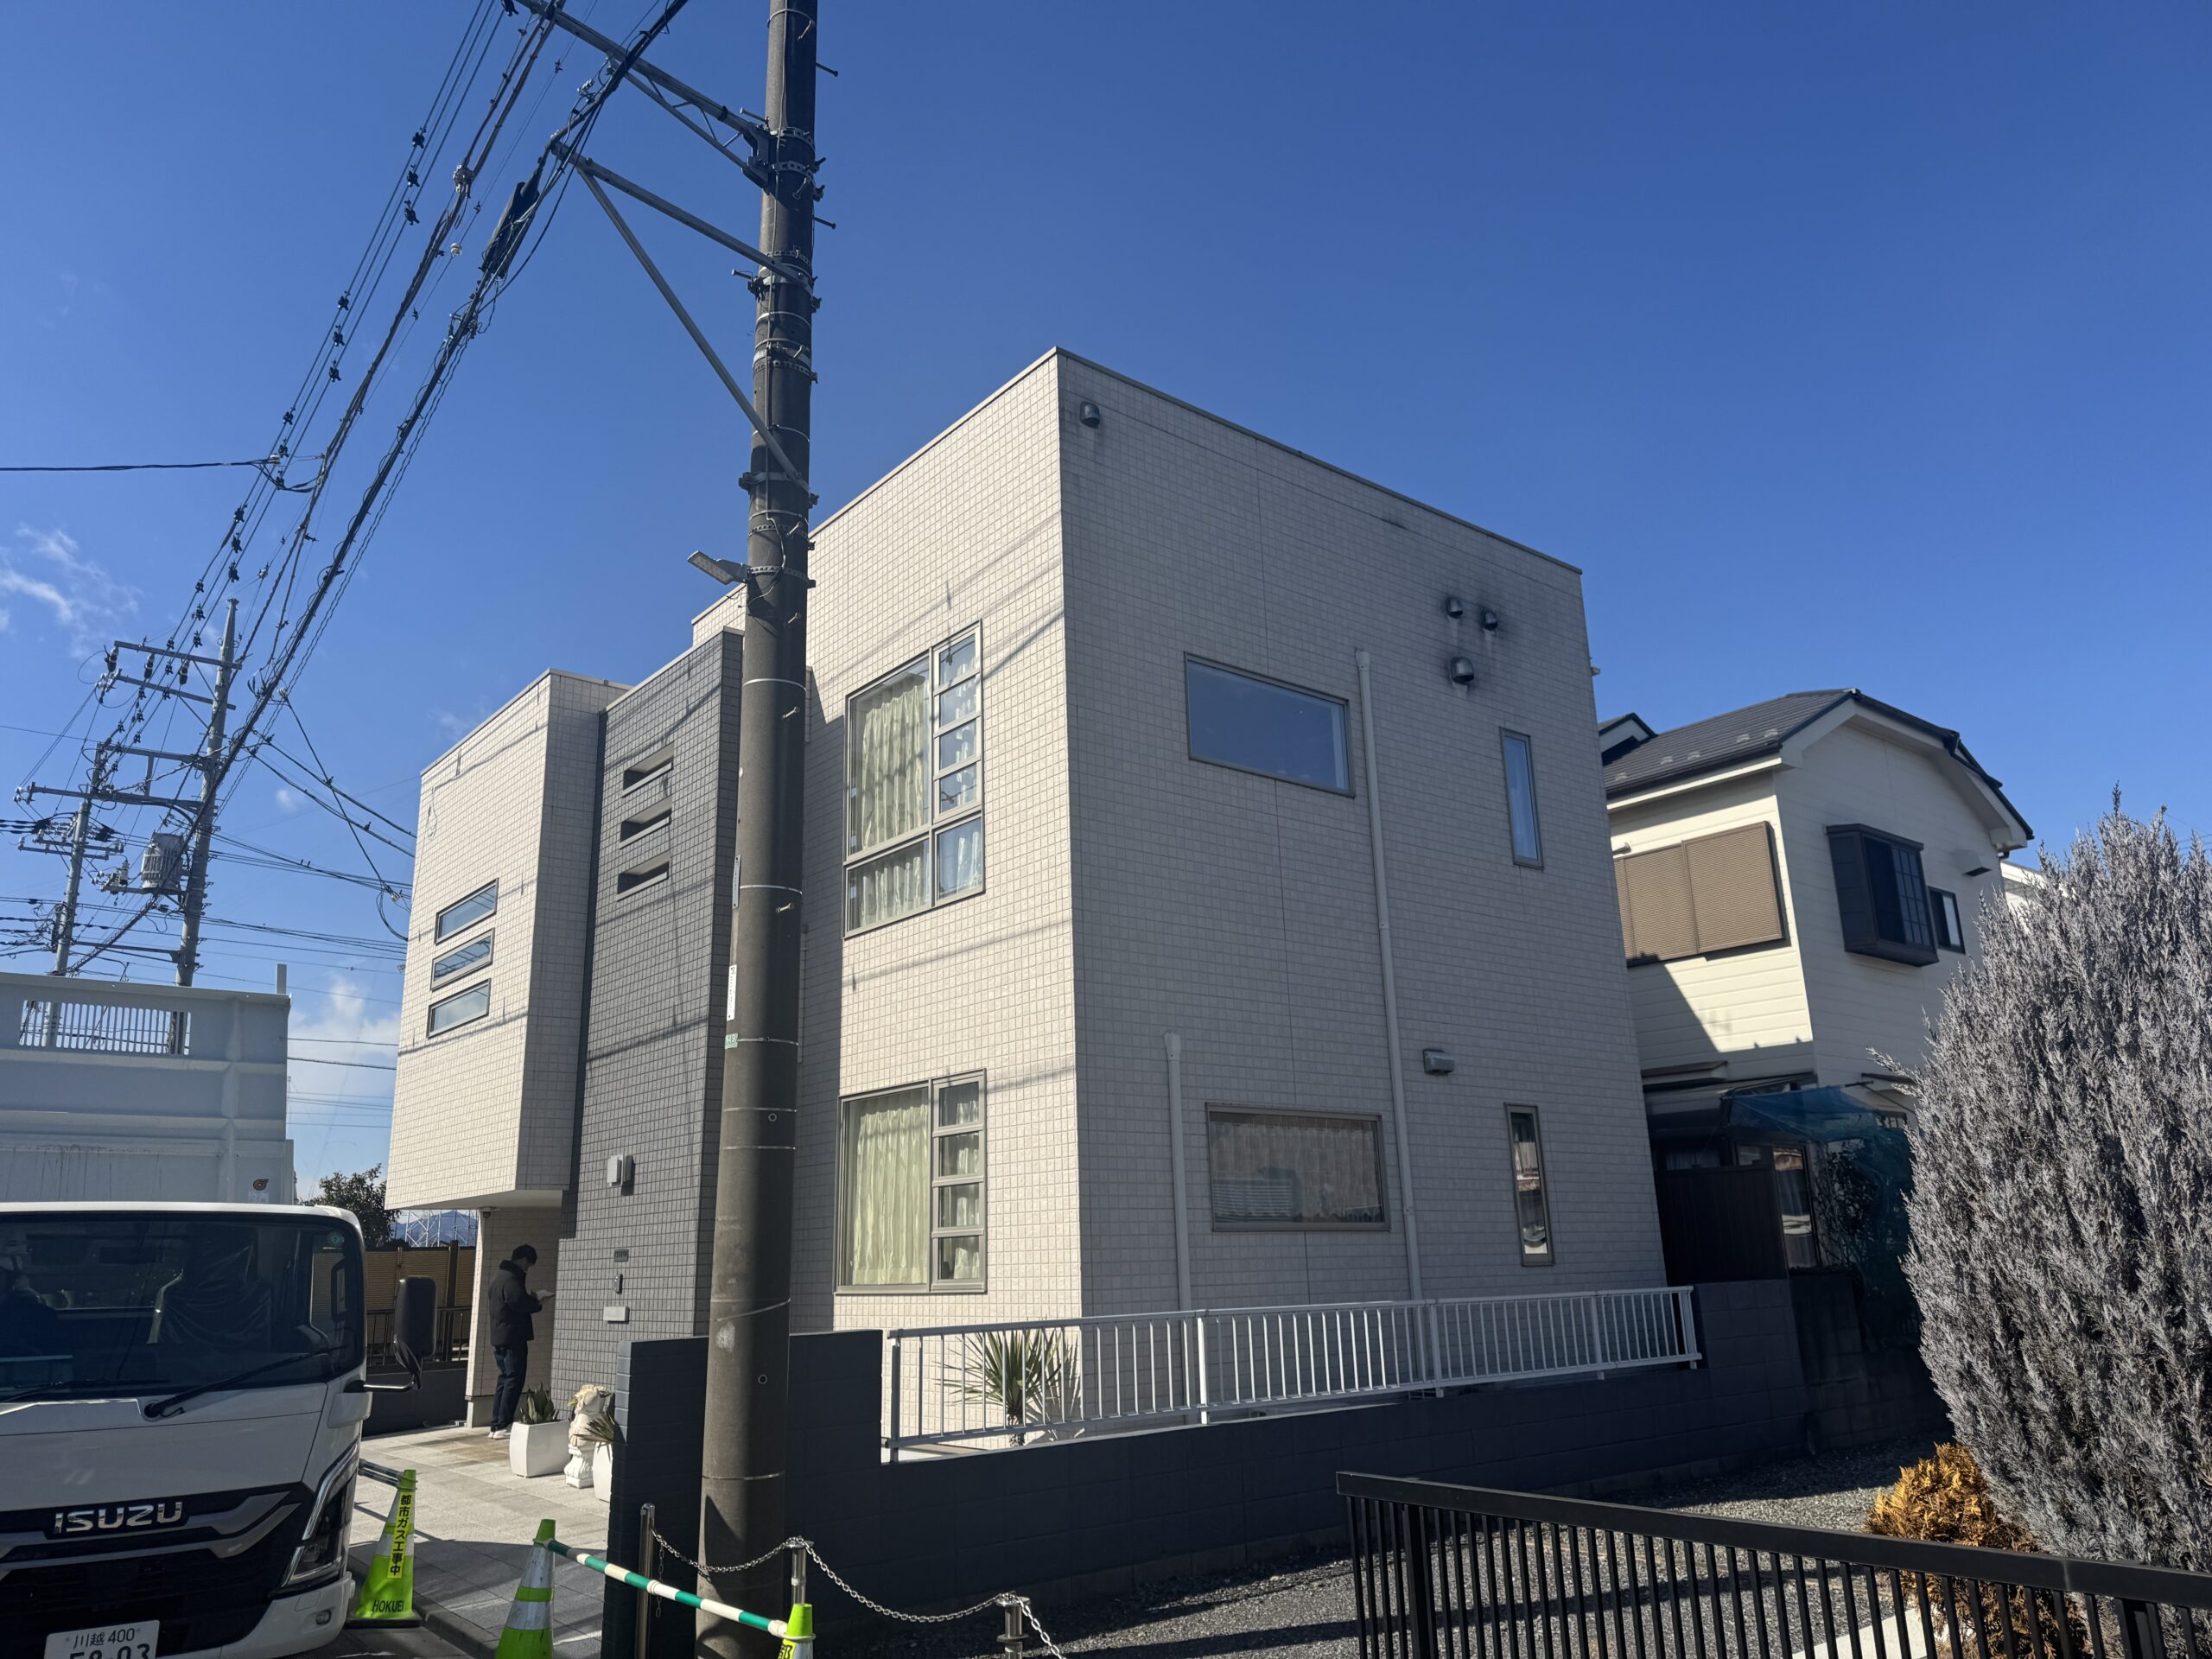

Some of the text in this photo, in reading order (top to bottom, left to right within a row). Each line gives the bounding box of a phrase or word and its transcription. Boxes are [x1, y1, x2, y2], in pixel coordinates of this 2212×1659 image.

[53, 1501, 183, 1535] ISUZU
[389, 1494, 413, 1577] 都市ガス工事中
[372, 1599, 404, 1613] HOKUEI
[73, 1627, 136, 1649] 川越 400
